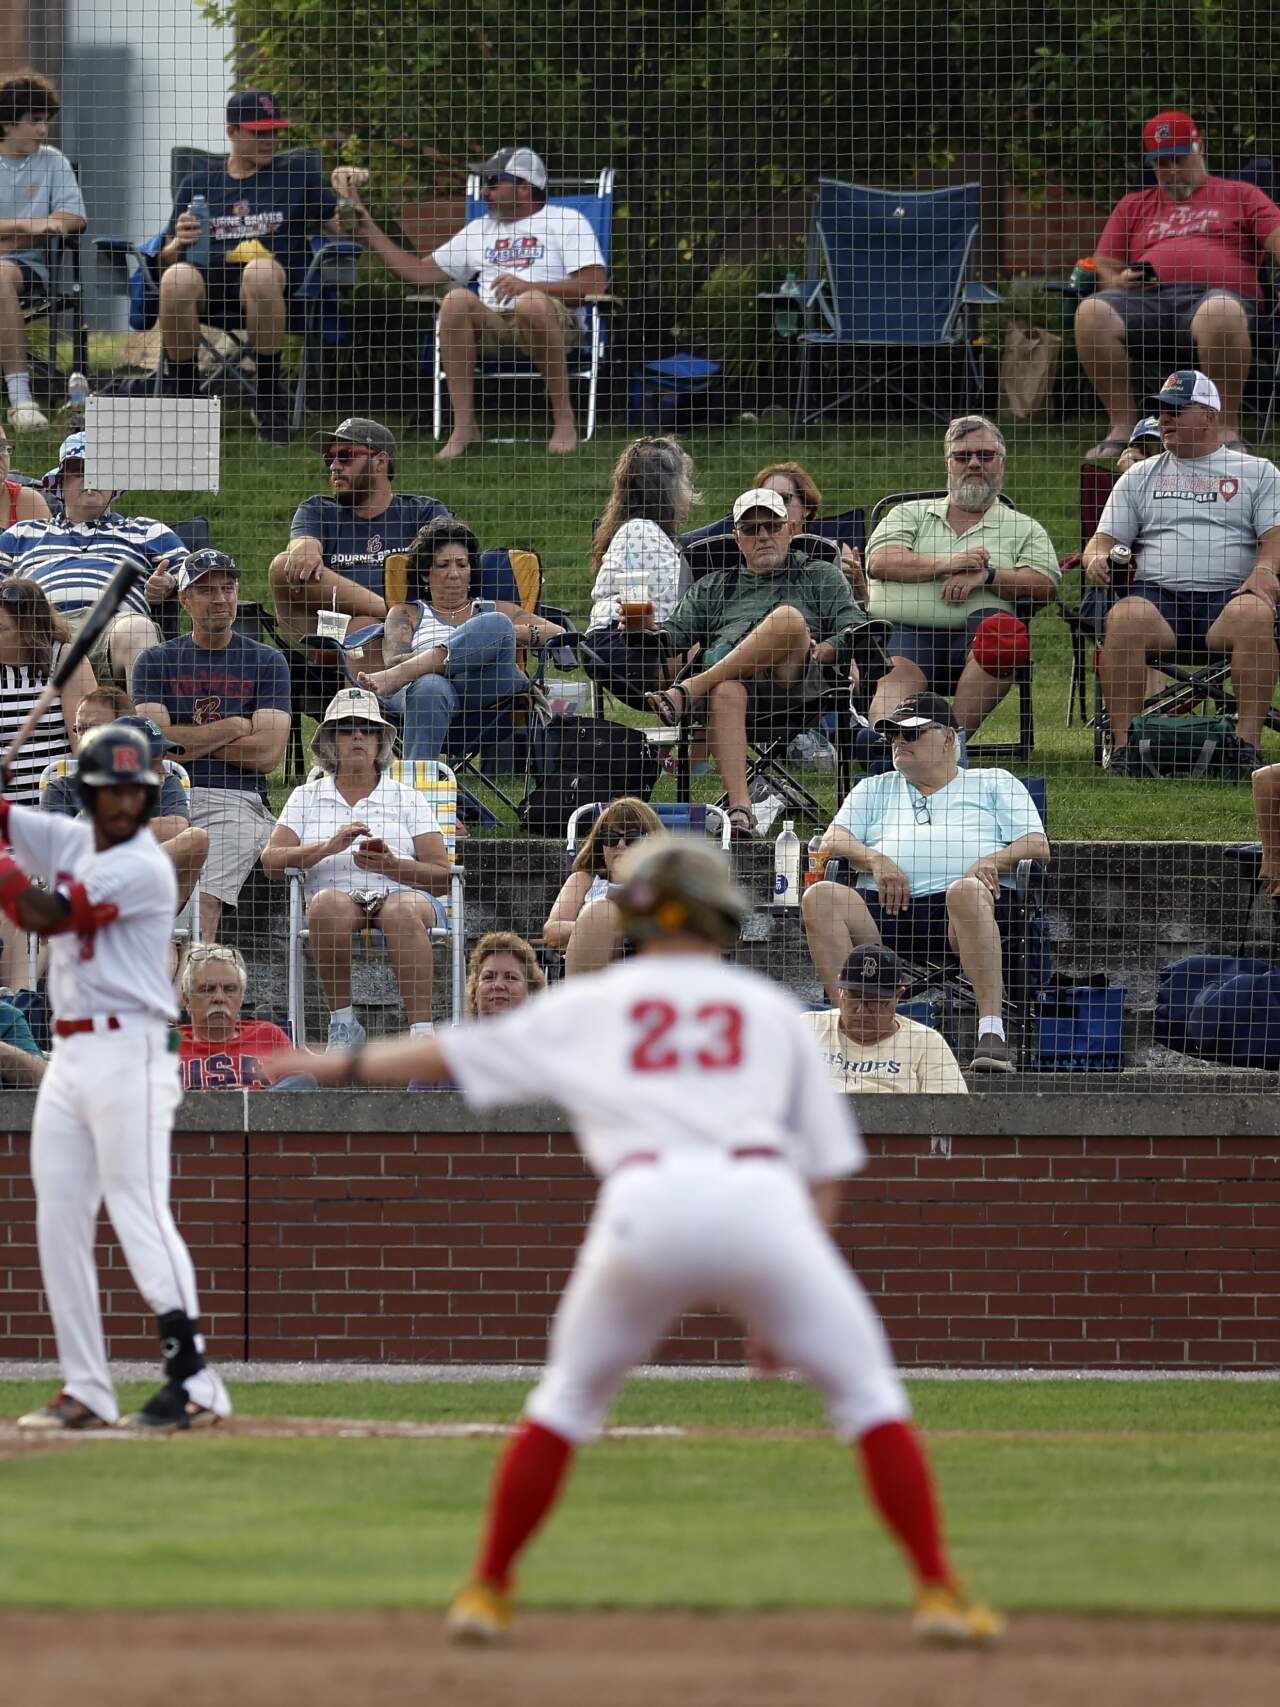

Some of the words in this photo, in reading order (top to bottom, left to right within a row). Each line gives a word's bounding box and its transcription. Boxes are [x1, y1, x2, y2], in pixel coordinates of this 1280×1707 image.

[1155, 491, 1215, 503] BASEBALL
[330, 552, 375, 565] BOURNE
[113, 745, 140, 772] R
[629, 998, 743, 1074] 23
